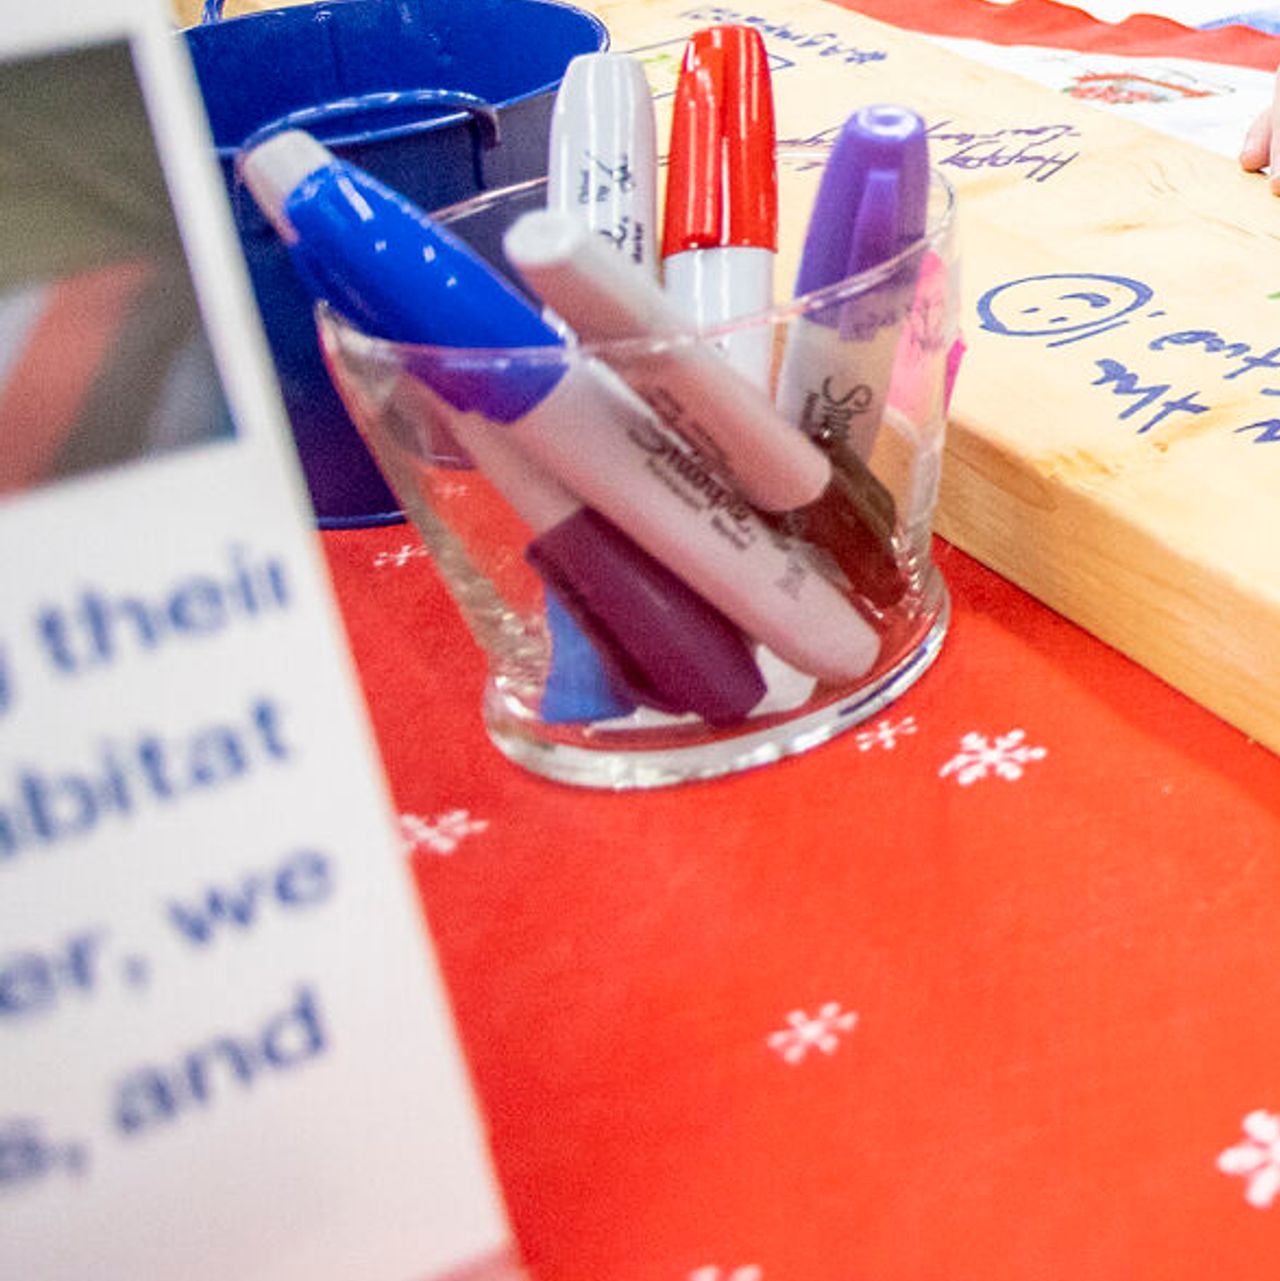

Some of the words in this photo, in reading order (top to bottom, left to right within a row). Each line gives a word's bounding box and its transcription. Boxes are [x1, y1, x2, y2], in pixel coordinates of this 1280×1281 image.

[1089, 357, 1210, 434] the
[166, 846, 336, 948] we
[110, 980, 330, 1140] and
